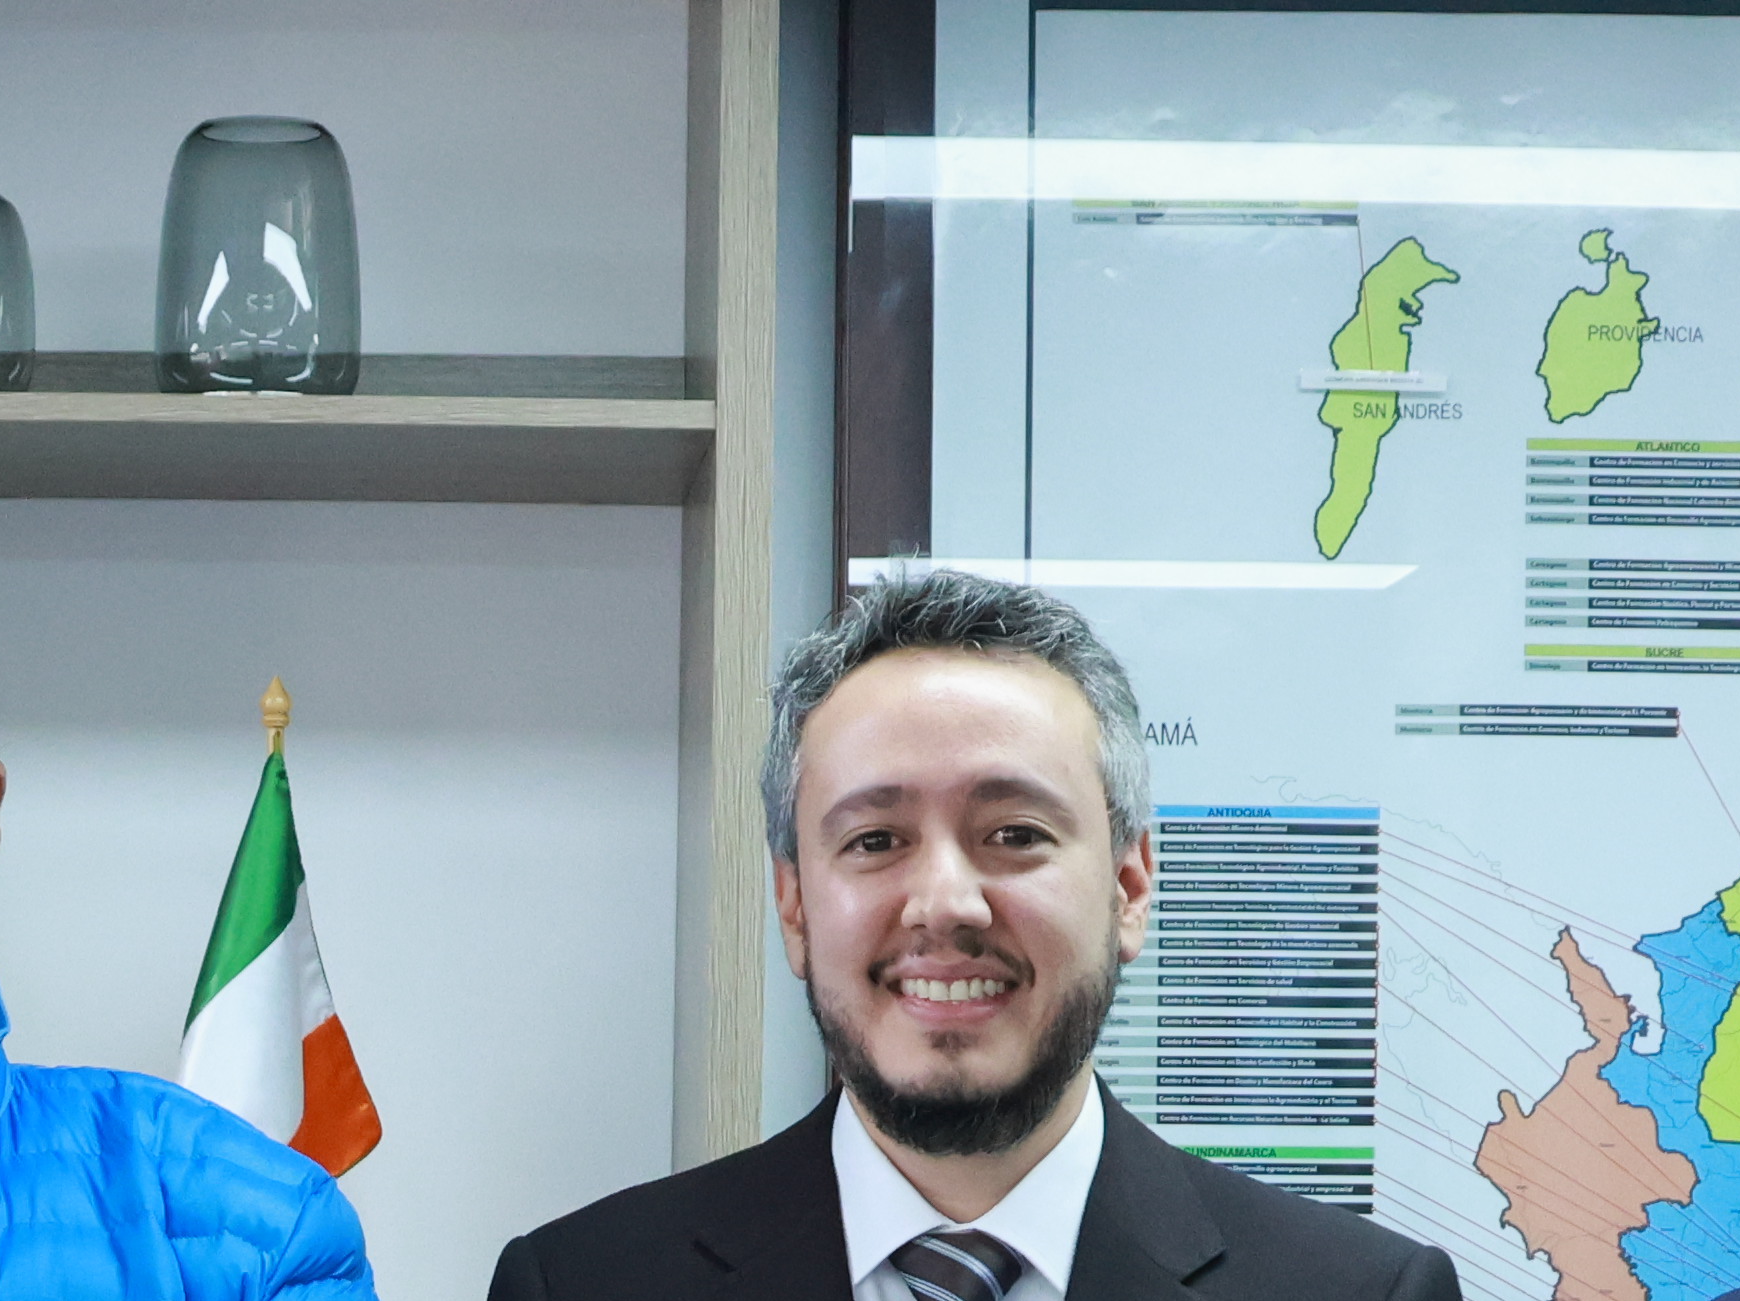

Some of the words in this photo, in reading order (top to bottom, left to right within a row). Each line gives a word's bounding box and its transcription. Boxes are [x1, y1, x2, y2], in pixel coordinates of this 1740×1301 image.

[1588, 324, 1703, 342] PROVIDENCIA
[1353, 403, 1386, 420] SAN
[1394, 402, 1462, 419] ANDRÉS
[1636, 442, 1700, 452] ATLANTICO
[1646, 648, 1684, 658] SUCRE
[1144, 717, 1198, 746] AMÁ
[1207, 808, 1271, 817] ANTIOQUIA
